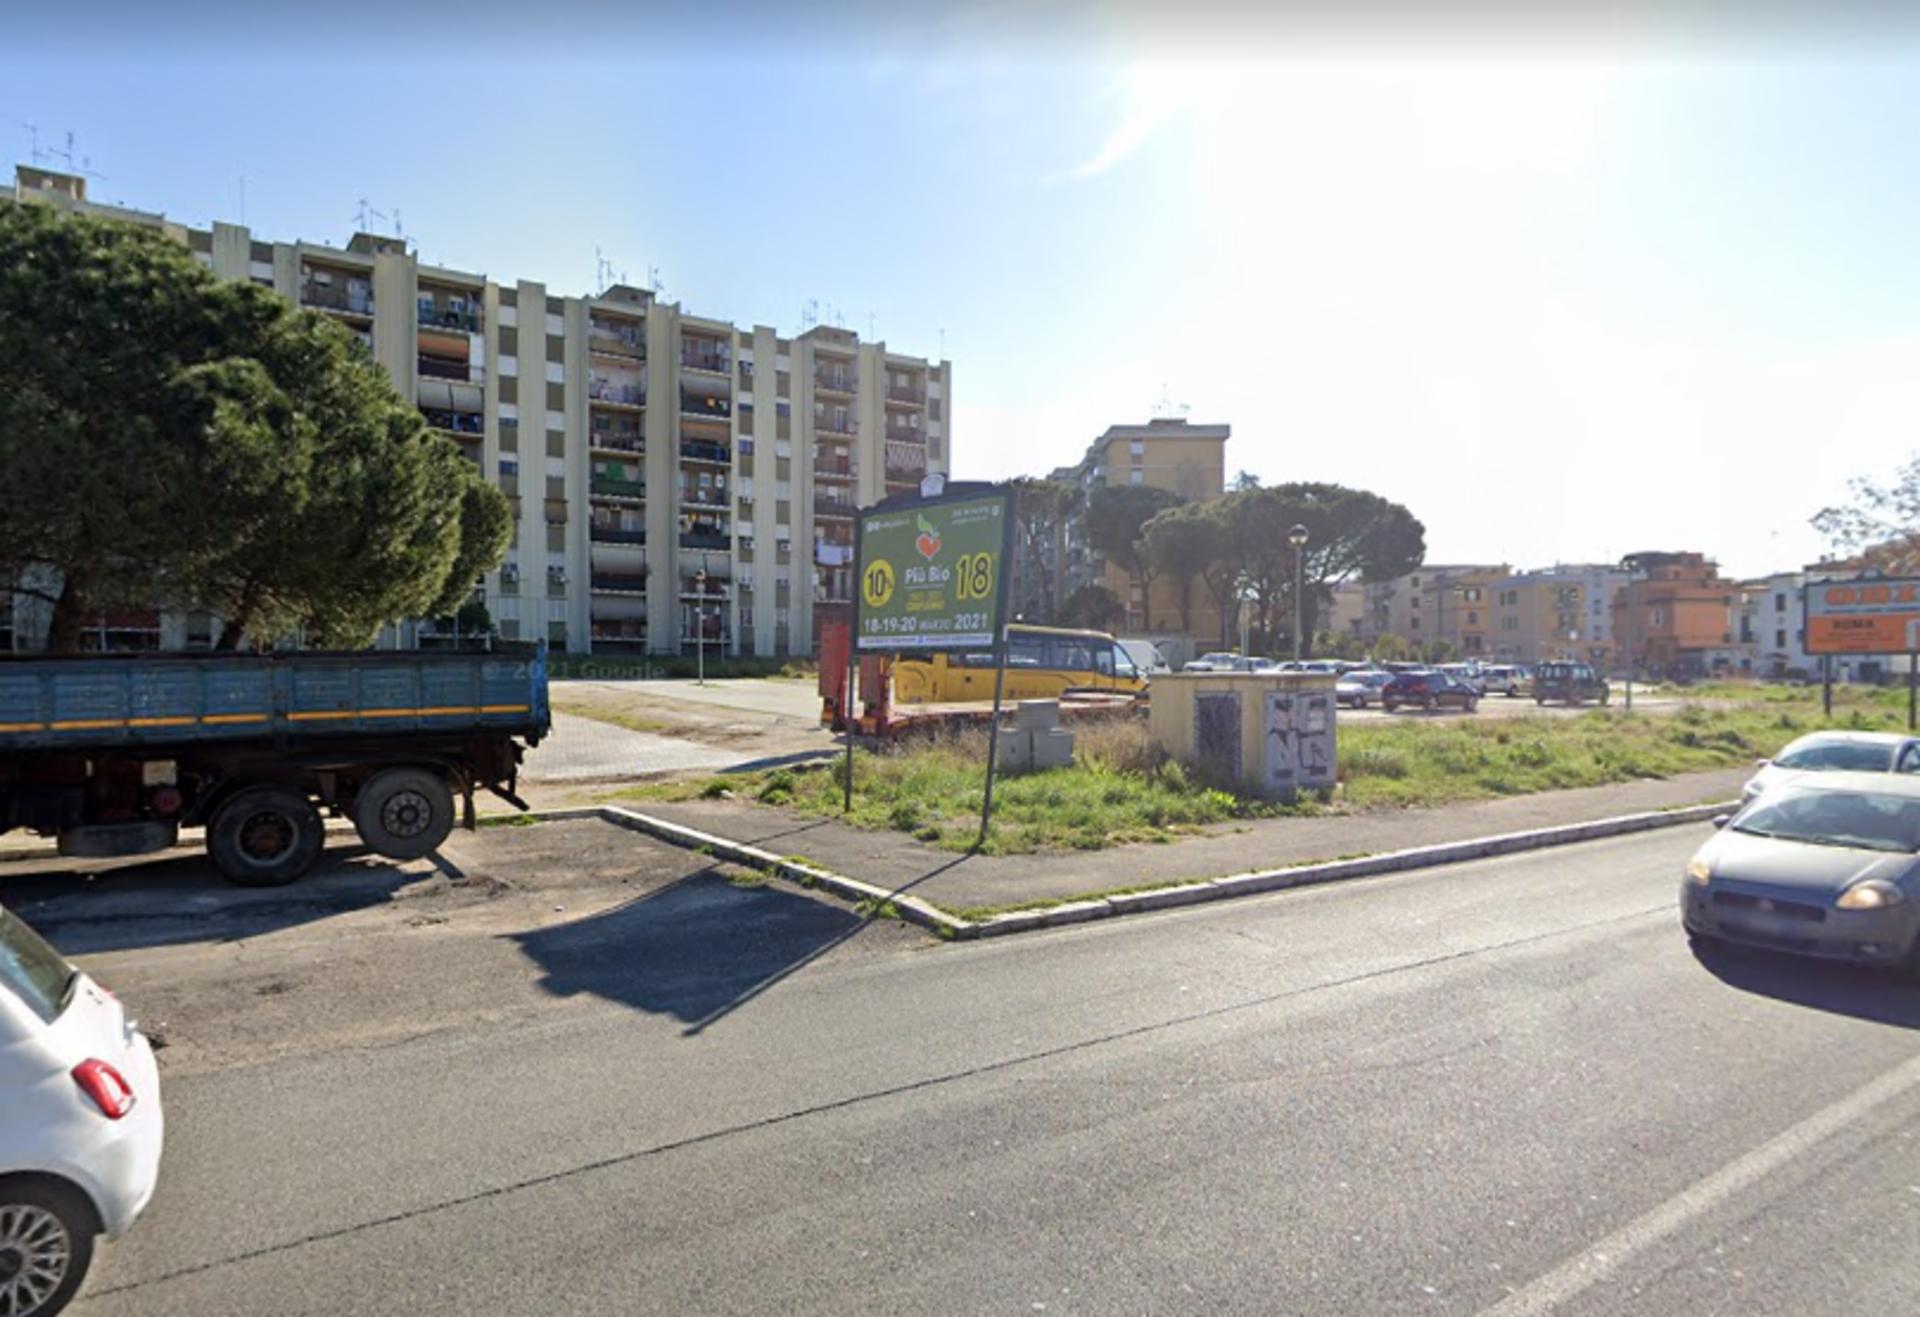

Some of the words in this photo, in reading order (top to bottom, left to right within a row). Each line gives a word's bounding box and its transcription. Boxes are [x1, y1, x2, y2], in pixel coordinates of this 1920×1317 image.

[928, 565, 950, 582] Bio
[864, 616, 917, 633] 18-19-20
[954, 613, 988, 630] 2021
